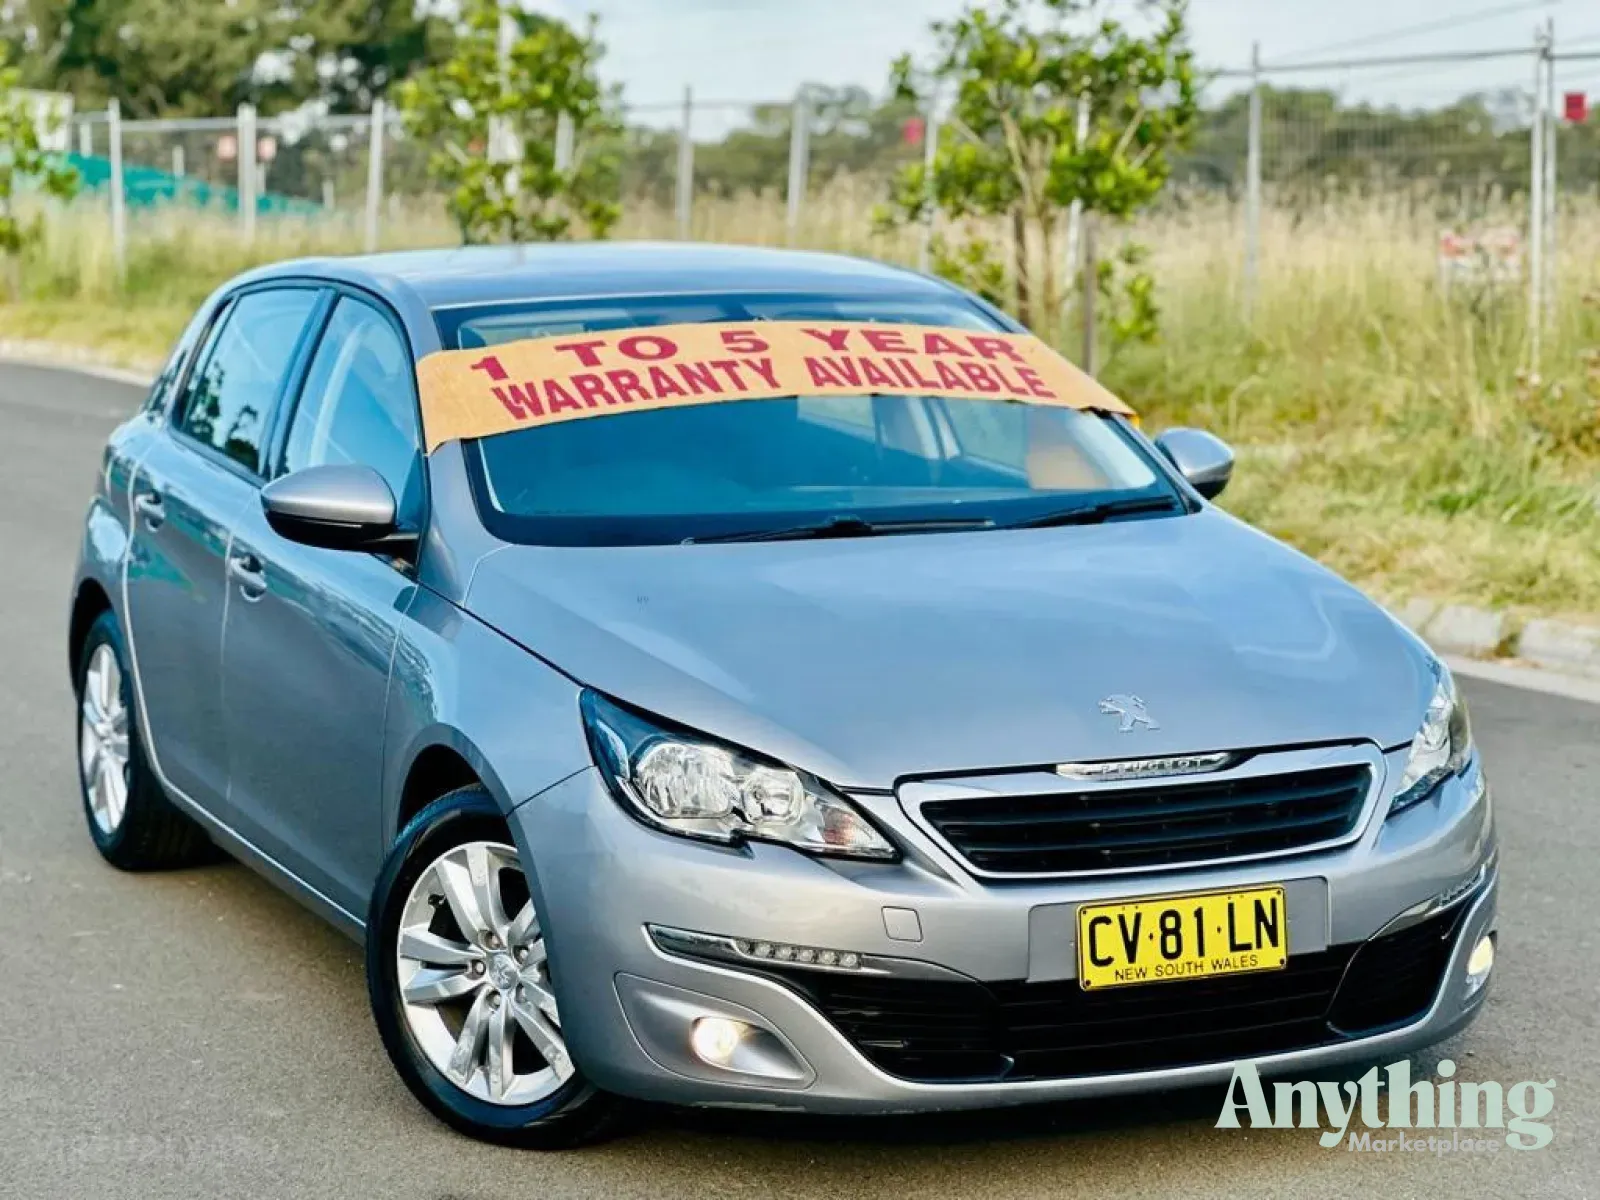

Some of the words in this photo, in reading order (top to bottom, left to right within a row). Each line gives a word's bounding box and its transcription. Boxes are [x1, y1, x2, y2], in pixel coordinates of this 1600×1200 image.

[470, 354, 509, 381] 1
[554, 335, 678, 368] TO
[719, 330, 770, 354] 5
[801, 328, 1024, 363] YEAR
[491, 357, 782, 420] WARRANTY
[803, 356, 1057, 399] AVAILABLE
[1114, 967, 1148, 982] NEW
[1155, 961, 1205, 977] SOUTH
[1211, 954, 1259, 970] WALES
